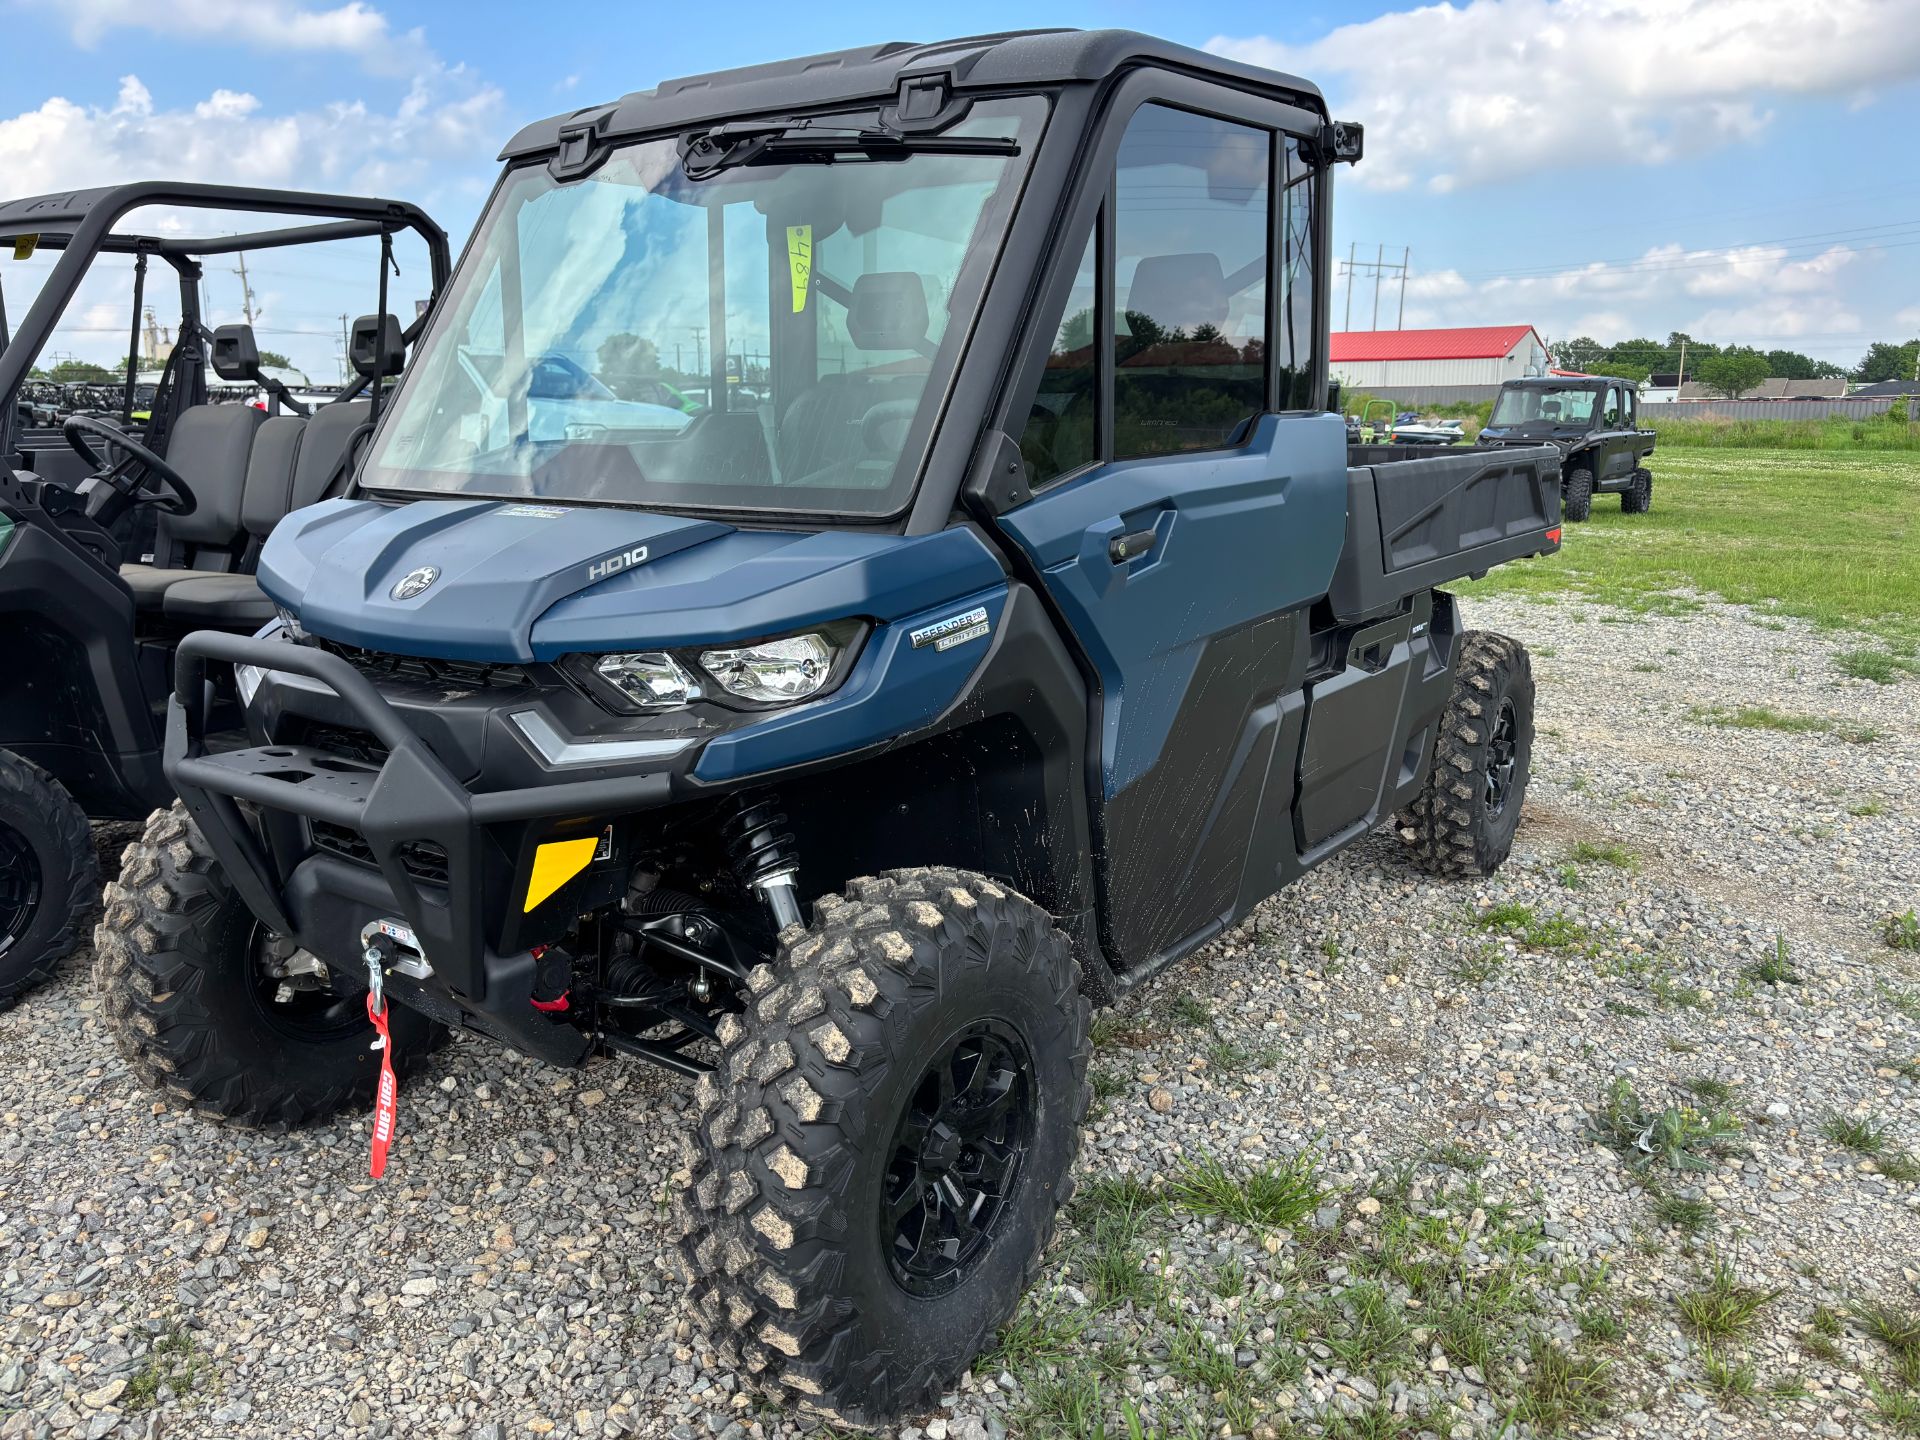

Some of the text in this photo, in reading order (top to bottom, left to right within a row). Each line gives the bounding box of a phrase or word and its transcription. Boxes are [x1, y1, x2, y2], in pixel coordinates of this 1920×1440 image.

[589, 546, 648, 581] HD10
[405, 580, 426, 589] BRP
[914, 610, 985, 643] DEFENDER PRO
[941, 625, 986, 646] LIMITED
[376, 1070, 392, 1142] can-am
